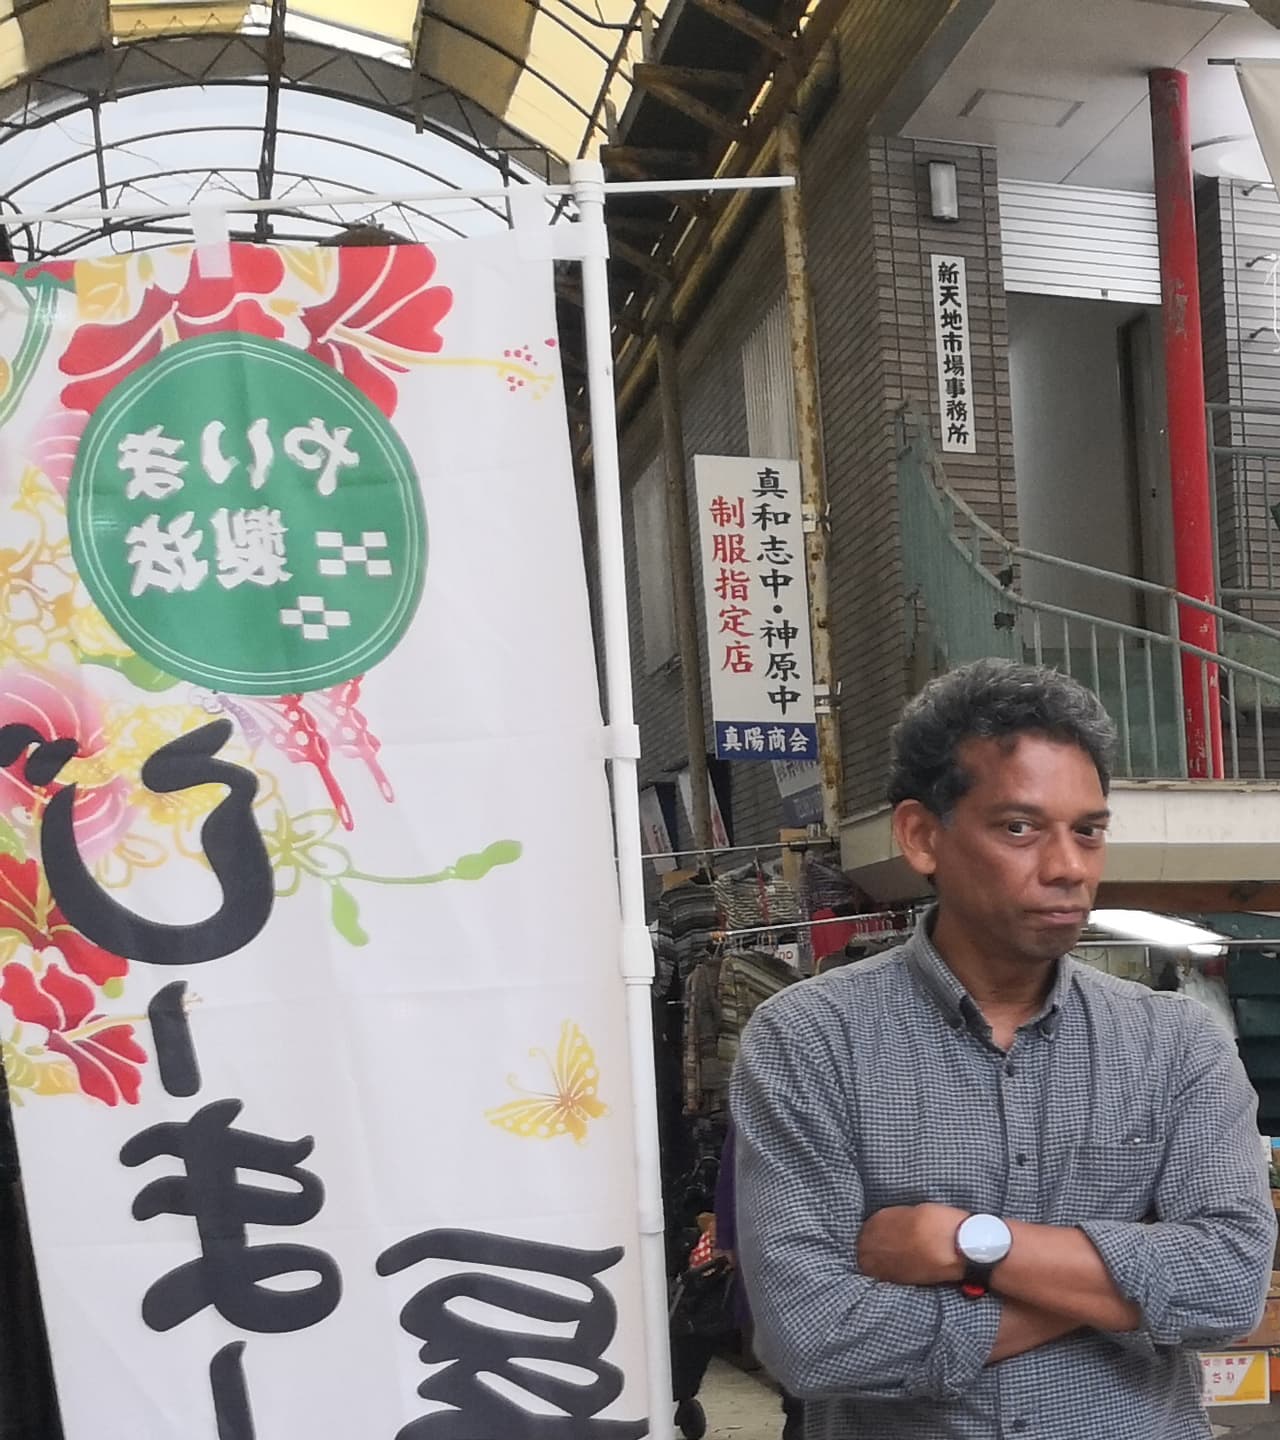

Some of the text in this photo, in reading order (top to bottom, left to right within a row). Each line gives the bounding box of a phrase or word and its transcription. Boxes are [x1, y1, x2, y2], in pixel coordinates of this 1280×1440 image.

[937, 261, 969, 445] 新天地市場事務所
[709, 496, 754, 674] 制服指定店
[752, 467, 801, 715] 真和志中・神原中
[722, 726, 809, 752] 真陽商会
